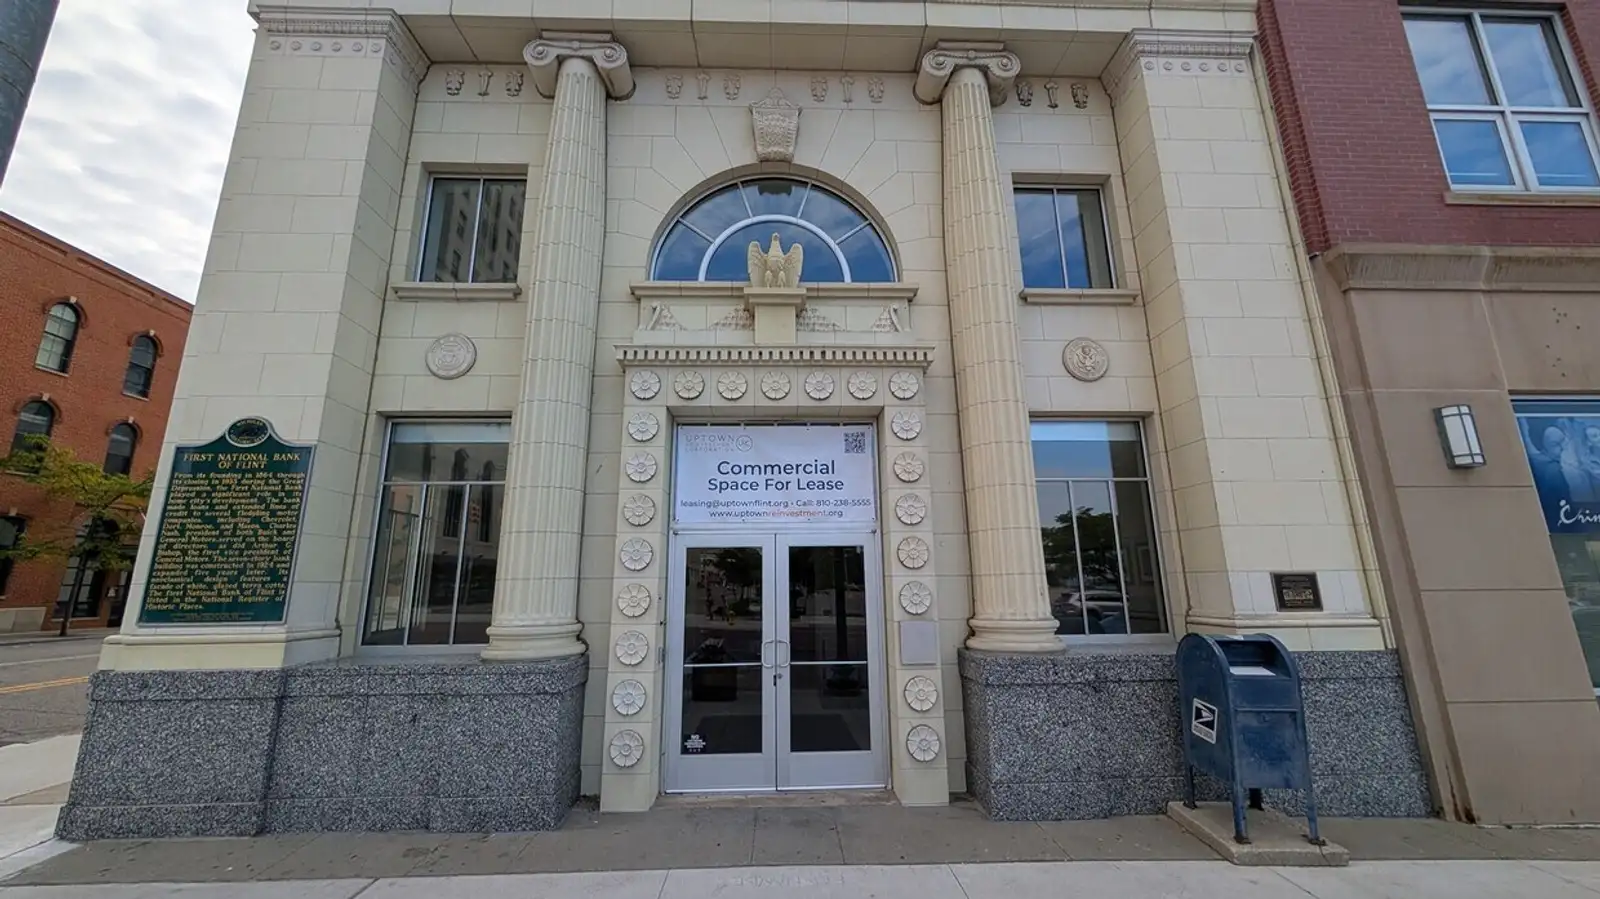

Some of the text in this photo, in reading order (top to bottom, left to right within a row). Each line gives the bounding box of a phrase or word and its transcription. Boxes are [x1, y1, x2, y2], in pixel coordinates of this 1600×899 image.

[184, 453, 214, 462] FIRST
[218, 453, 268, 461] NATIONAL
[218, 460, 268, 469] OF FLINT
[717, 460, 836, 475] Commercial
[708, 478, 844, 494] Space For Lease
[680, 500, 790, 508] leasing@uptownflint.org
[710, 510, 844, 518] www.uptownreinvestment.org
